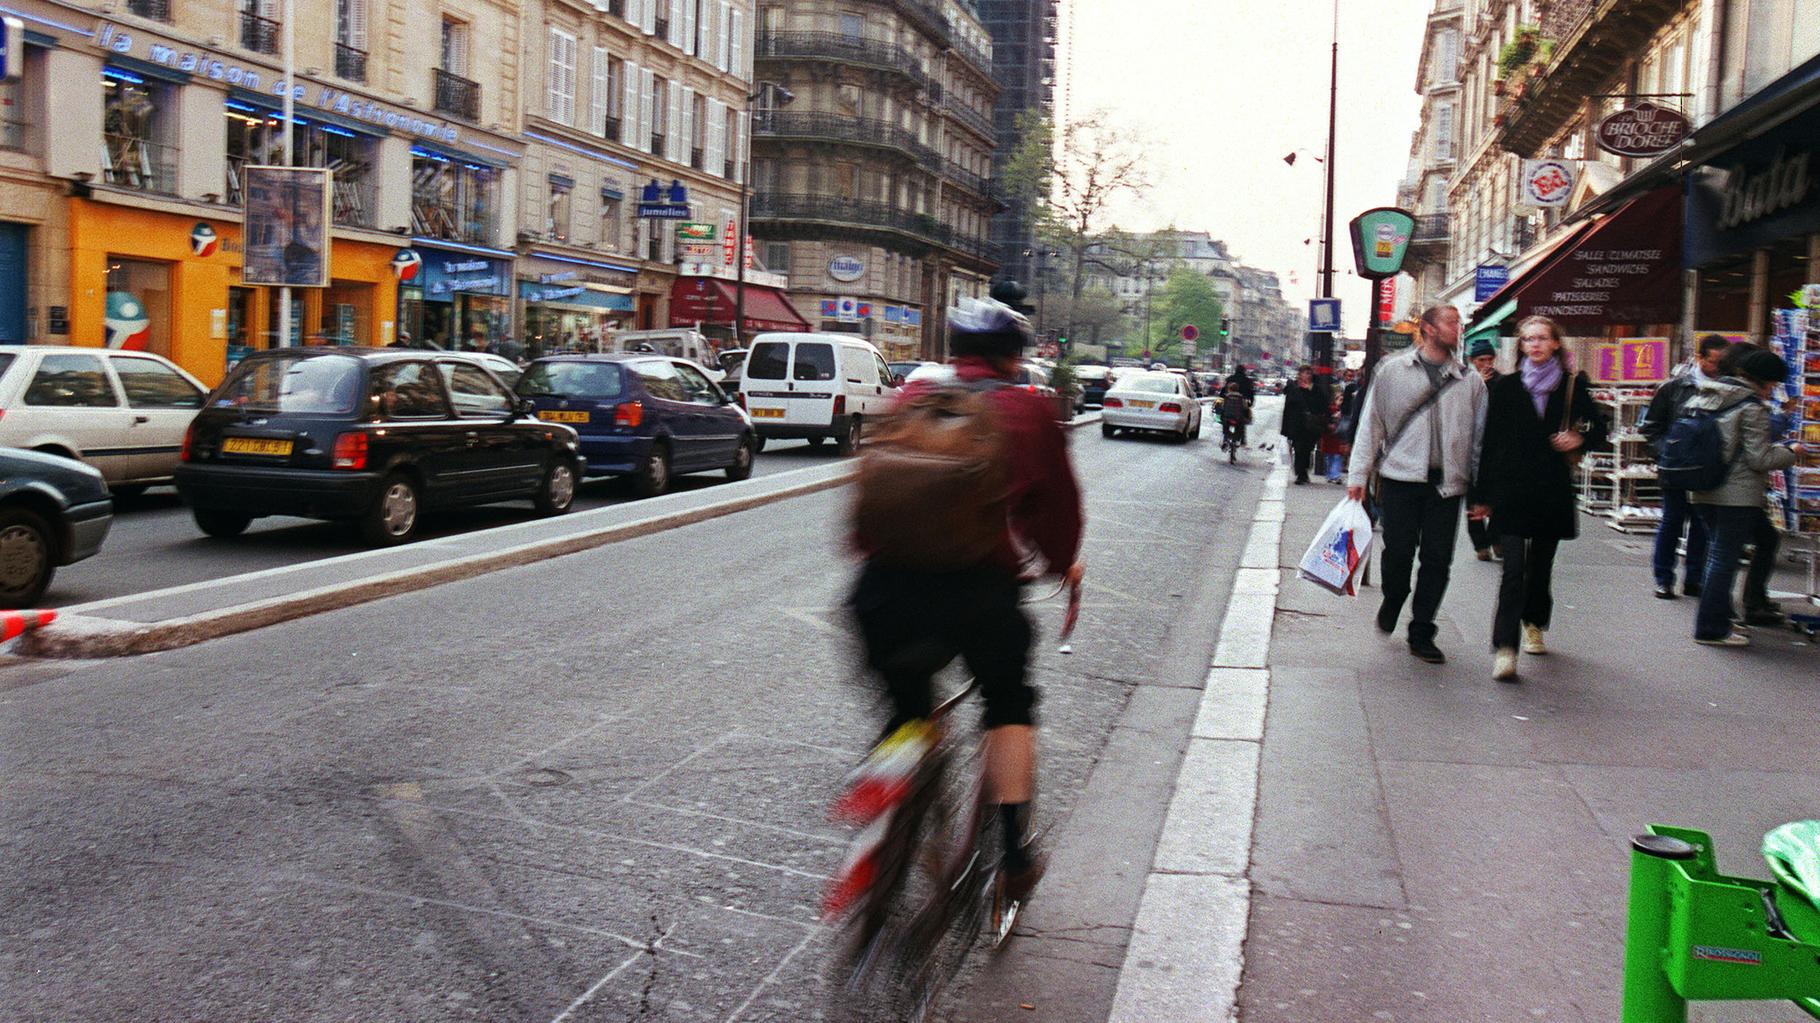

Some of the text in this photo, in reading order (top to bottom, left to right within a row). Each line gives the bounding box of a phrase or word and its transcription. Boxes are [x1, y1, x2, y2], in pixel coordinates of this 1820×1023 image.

[149, 43, 260, 89] maison
[1604, 121, 1682, 136] BRIOCHE
[1572, 278, 1620, 288] SALADES
